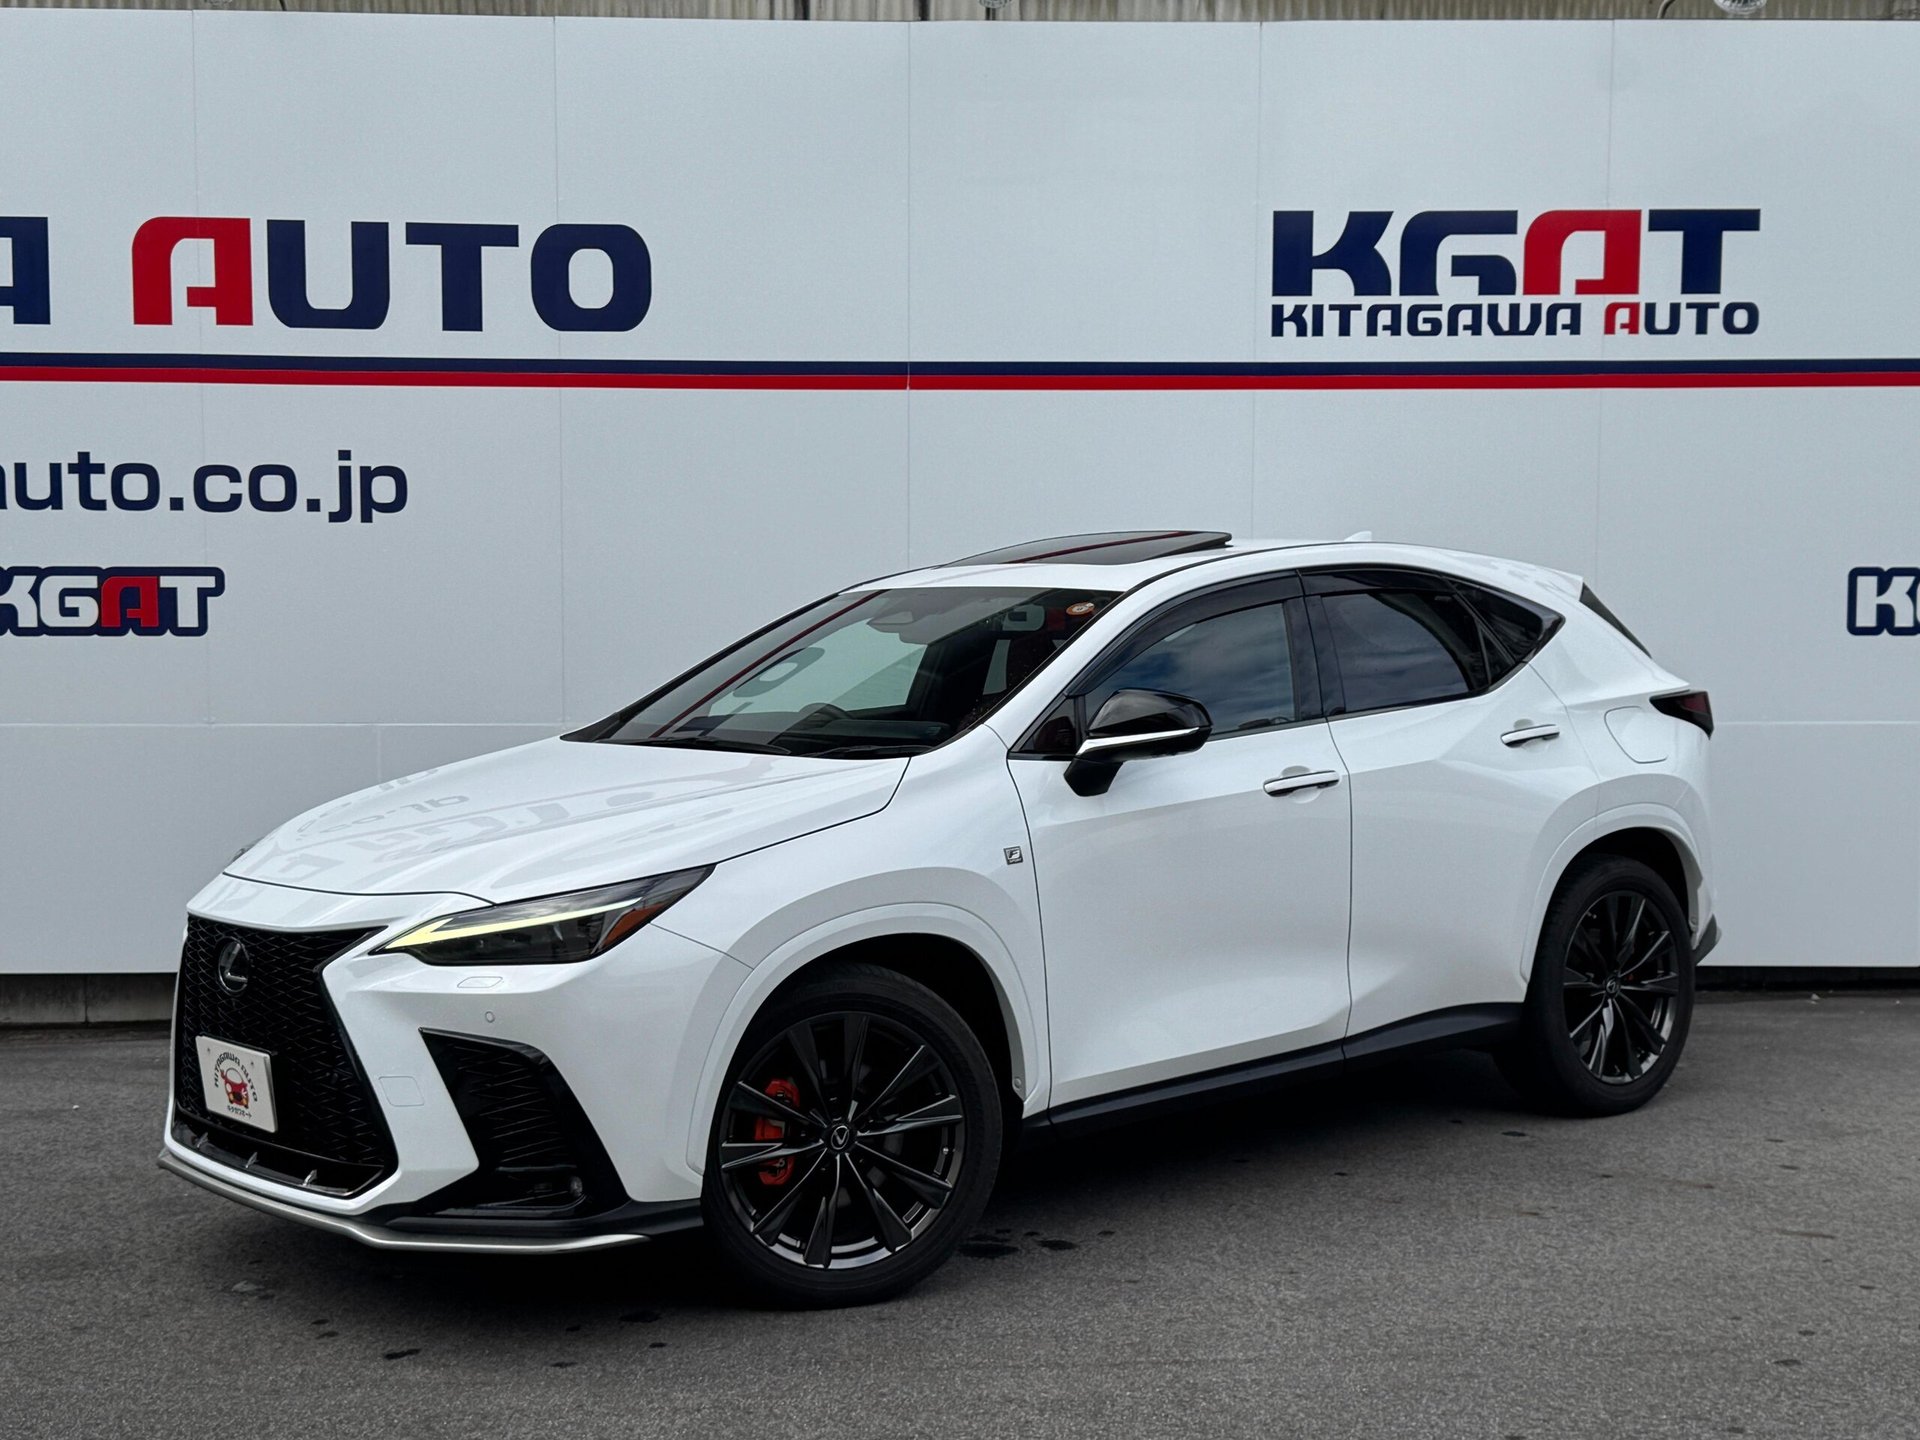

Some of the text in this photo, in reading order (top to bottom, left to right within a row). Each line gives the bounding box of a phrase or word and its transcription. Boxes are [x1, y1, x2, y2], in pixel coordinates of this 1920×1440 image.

[131, 216, 652, 332] AUTO
[1273, 209, 1761, 296] KGAT
[1272, 301, 1759, 338] KITAGAWA AUTO
[0, 450, 408, 523] uto.co.jp
